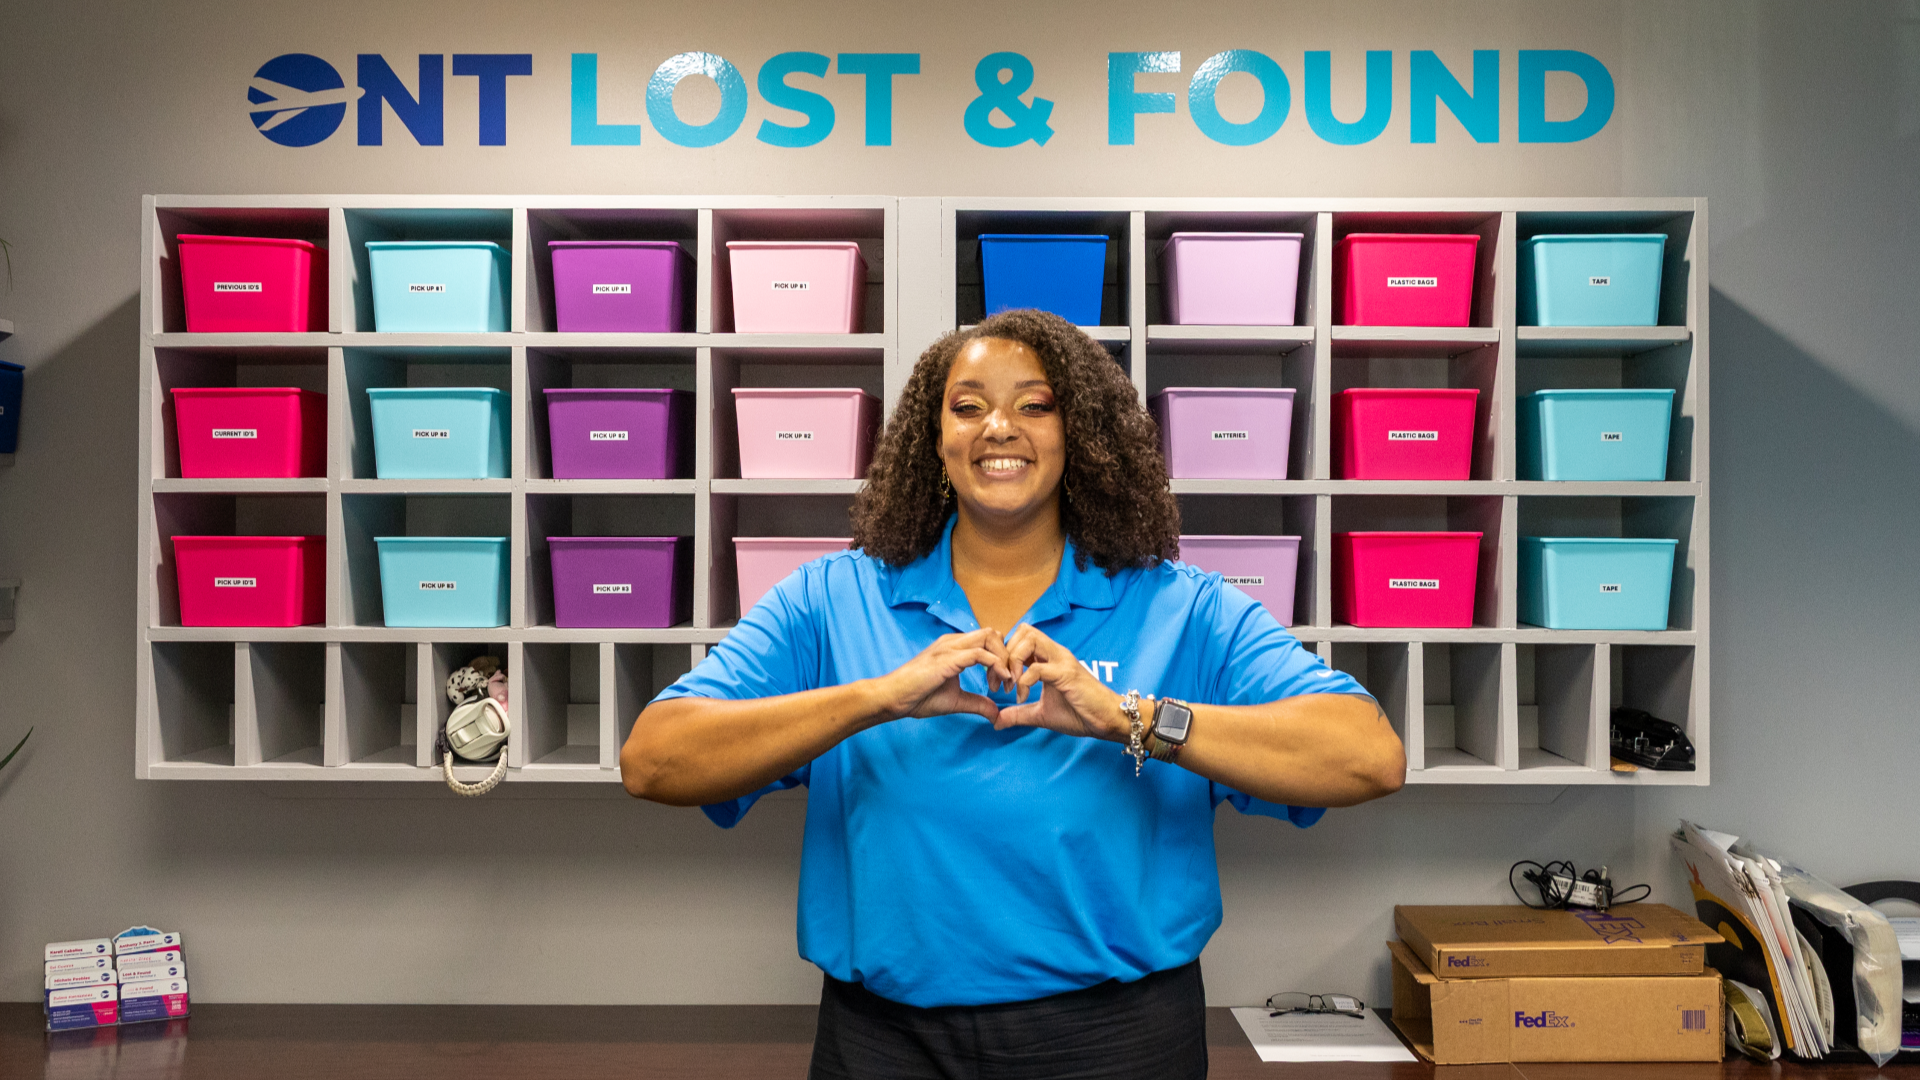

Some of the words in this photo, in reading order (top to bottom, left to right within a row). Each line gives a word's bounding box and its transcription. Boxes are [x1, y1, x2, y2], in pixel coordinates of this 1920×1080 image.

[248, 53, 532, 148] ONT
[571, 51, 920, 148] LOST
[964, 51, 1055, 148] &
[1107, 49, 1615, 146] FOUND
[1078, 660, 1119, 682] NT
[1448, 956, 1485, 967] FedEx
[1514, 1011, 1569, 1028] FedEx
